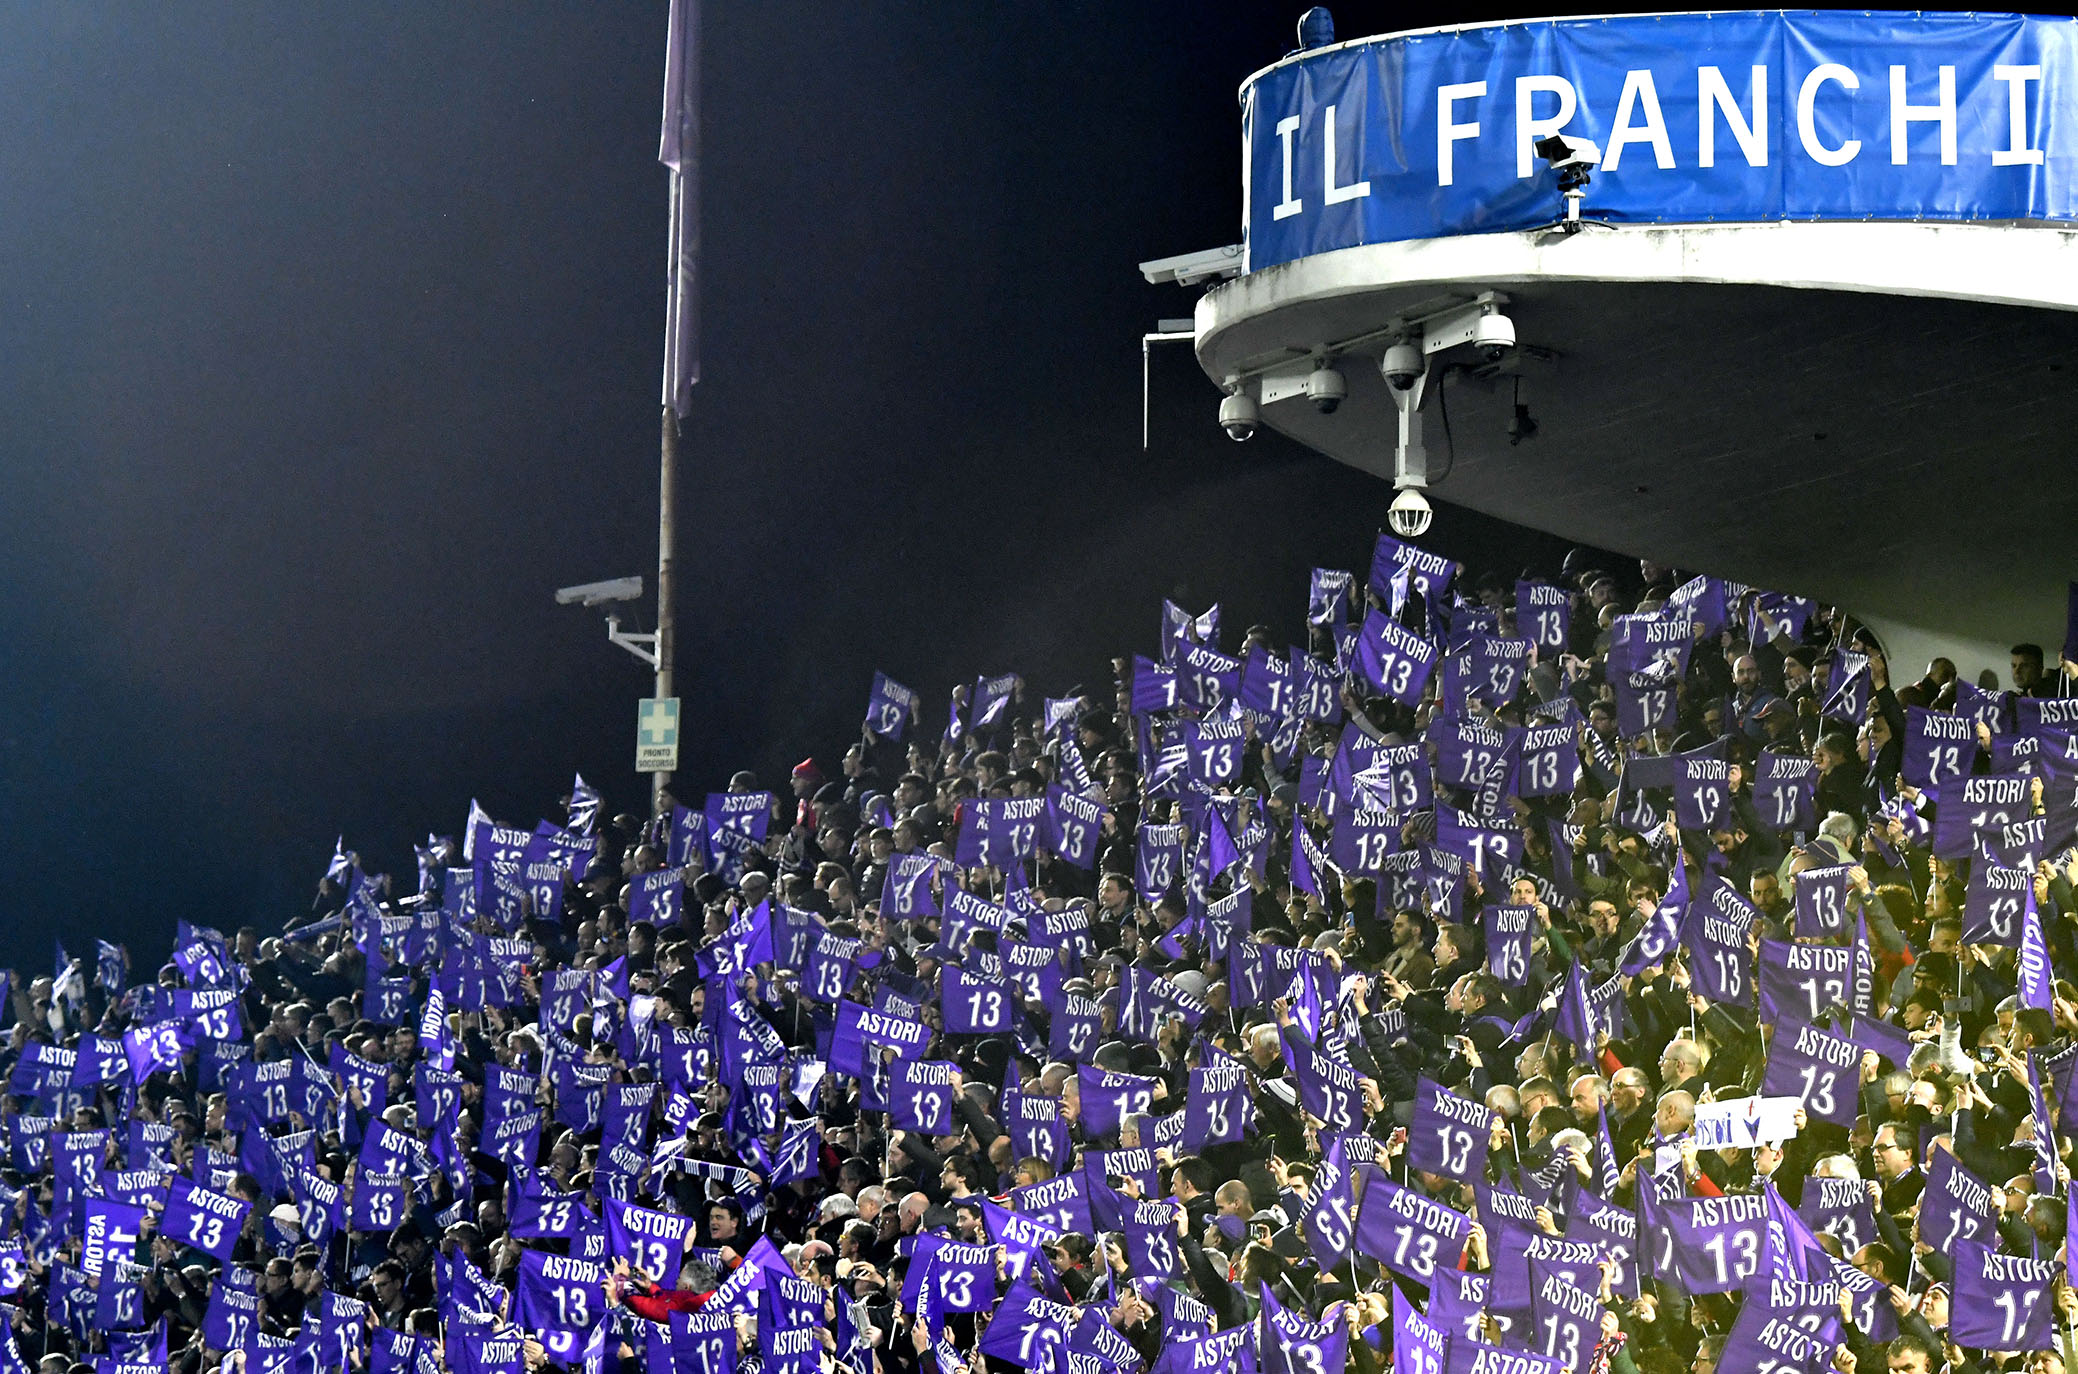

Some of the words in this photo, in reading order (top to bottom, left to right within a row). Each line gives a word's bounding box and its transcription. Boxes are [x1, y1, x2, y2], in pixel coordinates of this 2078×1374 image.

[1273, 104, 1371, 221] IL
[1436, 64, 2044, 186] FRANCHI
[1393, 544, 1447, 576] ASTORI
[1382, 623, 1432, 663] ASTORI
[1537, 611, 1564, 646] 13
[1645, 620, 1691, 643] ASTORI
[1484, 640, 1526, 659] ASTORI
[1193, 674, 1220, 706] 13
[1381, 653, 1412, 694] 13
[1489, 664, 1514, 695] 13
[882, 678, 911, 706] ASTORI
[1310, 682, 1332, 718] 13
[1638, 690, 1666, 726] 13
[881, 702, 900, 732] 13
[1198, 720, 1242, 741] ASTORI
[1923, 715, 1970, 740] ASTORI
[1458, 723, 1503, 748] ASTORI
[1524, 726, 1573, 751] ASTORI
[1201, 744, 1233, 777] 13
[1371, 746, 1420, 768] ASTORI
[1460, 749, 1491, 785] 13
[1528, 751, 1558, 790] 13
[1687, 760, 1727, 780] ASTORI
[1929, 746, 1960, 784] 13
[721, 791, 767, 812] ASTORI
[1694, 786, 1720, 824] 13
[1772, 787, 1798, 824] 13
[1962, 779, 2026, 802] ASTORI
[1058, 792, 1100, 824] ASTORI
[1352, 808, 1399, 828] ASTORI
[1009, 825, 1035, 856] 13
[1060, 820, 1085, 858] 13
[1356, 834, 1387, 870] 13
[526, 864, 562, 881] ASTORI
[1150, 854, 1170, 889] 13
[1431, 849, 1461, 875] ASTORI
[530, 887, 552, 915] 13
[950, 891, 1002, 926] ASTORI
[1712, 886, 1754, 929] ASTORI
[1812, 886, 1840, 928] 13
[1046, 908, 1089, 935] ASTORI
[1496, 910, 1529, 933] ASTORI
[1704, 916, 1742, 948] ASTORI
[817, 933, 859, 959] ASTORI
[1009, 945, 1054, 966] ASTORI
[1502, 940, 1526, 979] 13
[818, 960, 842, 998] 13
[1714, 953, 1741, 996] 13
[968, 991, 1001, 1027] 13
[1800, 978, 1844, 1018] 13
[197, 1009, 229, 1039] 13
[729, 1000, 785, 1056] ASTORI
[856, 1012, 922, 1044] ASTORI
[1068, 1023, 1092, 1054] 13
[1794, 1027, 1859, 1068] ASTORI
[255, 1062, 292, 1082] ASTORI
[906, 1062, 950, 1086] ASTORI
[1310, 1051, 1355, 1090] ASTORI
[262, 1084, 288, 1118] 13
[1321, 1085, 1352, 1128] 13
[1800, 1065, 1834, 1115] 13
[494, 1110, 538, 1139] ASTORI
[912, 1092, 941, 1129] 13
[1021, 1098, 1055, 1121] ASTORI
[1434, 1091, 1490, 1129] ASTORI
[608, 1145, 646, 1176] ASTORI
[790, 1137, 810, 1176] 13
[1104, 1149, 1151, 1175] ASTORI
[1437, 1126, 1473, 1174] 13
[73, 1154, 96, 1184] 13
[186, 1186, 242, 1219] ASTORI
[1490, 1190, 1536, 1220] ASTORI
[1820, 1179, 1866, 1208] ASTORI
[1946, 1166, 1991, 1217] ASTORI
[302, 1200, 326, 1240] 13
[370, 1192, 393, 1226] 13
[538, 1200, 572, 1233] 13
[622, 1207, 686, 1240] ASTORI
[1134, 1202, 1171, 1225] ASTORI
[1389, 1188, 1461, 1240] ASTORI
[1692, 1195, 1768, 1228] ASTORI
[189, 1213, 222, 1248] 13
[631, 1239, 667, 1282] 13
[1145, 1233, 1173, 1273] 13
[1394, 1225, 1438, 1278] 13
[1523, 1235, 1600, 1264] ASTORI
[1705, 1231, 1758, 1284] 13
[542, 1254, 599, 1284] ASTORI
[779, 1276, 823, 1304] ASTORI
[939, 1271, 974, 1308] 13
[1541, 1274, 1600, 1323] ASTORI
[552, 1286, 589, 1327] 13
[686, 1311, 732, 1334] ASTORI
[1024, 1297, 1078, 1333] ASTORI
[1173, 1295, 1208, 1323] ASTORI
[226, 1313, 250, 1348] 13
[773, 1328, 813, 1355] ASTORI
[1545, 1313, 1579, 1370] 13
[1092, 1325, 1141, 1370] ASTORI
